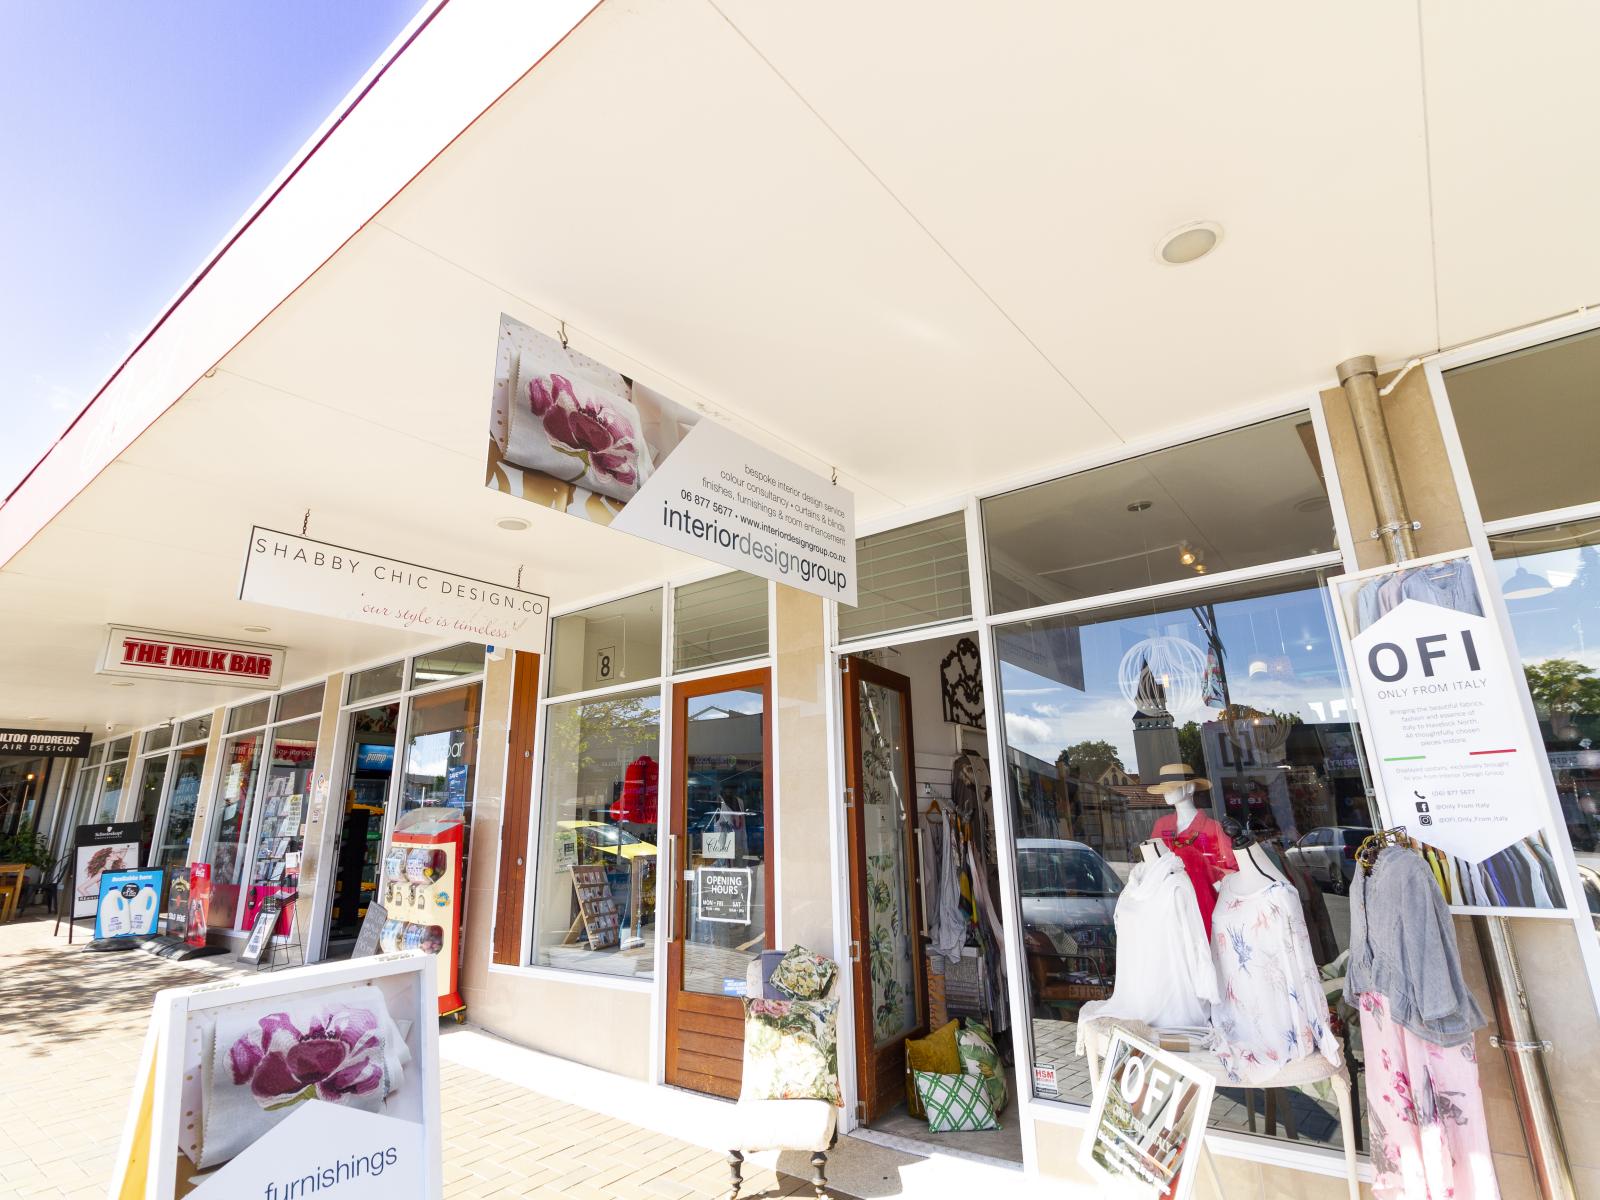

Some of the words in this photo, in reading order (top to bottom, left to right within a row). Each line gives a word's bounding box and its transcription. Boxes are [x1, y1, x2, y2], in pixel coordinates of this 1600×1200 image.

[702, 476, 735, 500] finishes,
[737, 491, 776, 518] furnishings
[778, 510, 784, 520] &
[785, 514, 803, 528] room
[803, 523, 846, 547] enhancement
[720, 470, 745, 488] colour
[746, 482, 789, 509] consultancy
[794, 504, 821, 521] curtains
[827, 516, 845, 533] blinds
[745, 464, 776, 487] bespoke
[777, 480, 800, 497] interior
[802, 492, 822, 509] design
[824, 504, 845, 519] service
[663, 499, 847, 592] interiordesigngroup
[680, 489, 692, 502] 06
[694, 494, 711, 509] 877
[712, 502, 733, 518] 5677
[740, 514, 846, 563] www.interiordesigngroup.co.nz
[255, 537, 360, 574] SHABBY
[373, 566, 429, 590] CHIC
[441, 581, 544, 616] DESIGN.CO
[361, 600, 391, 616] our
[394, 604, 432, 628] style
[435, 612, 449, 627] is
[453, 618, 511, 640] timeless
[123, 640, 170, 665] THE
[170, 646, 228, 671] MILK
[228, 653, 273, 676] BAR
[601, 655, 610, 677] 8
[1368, 629, 1481, 683] OFI
[1377, 687, 1409, 700] ONLY
[1412, 684, 1449, 697] FROM
[1452, 678, 1488, 691] ITALY
[30, 735, 80, 745] ANDREWS
[30, 744, 73, 752] DESIGN
[706, 875, 742, 886] OPENING
[711, 885, 739, 895] HOURS
[1035, 1069, 1054, 1079] HSM
[1120, 1055, 1183, 1131] OFI
